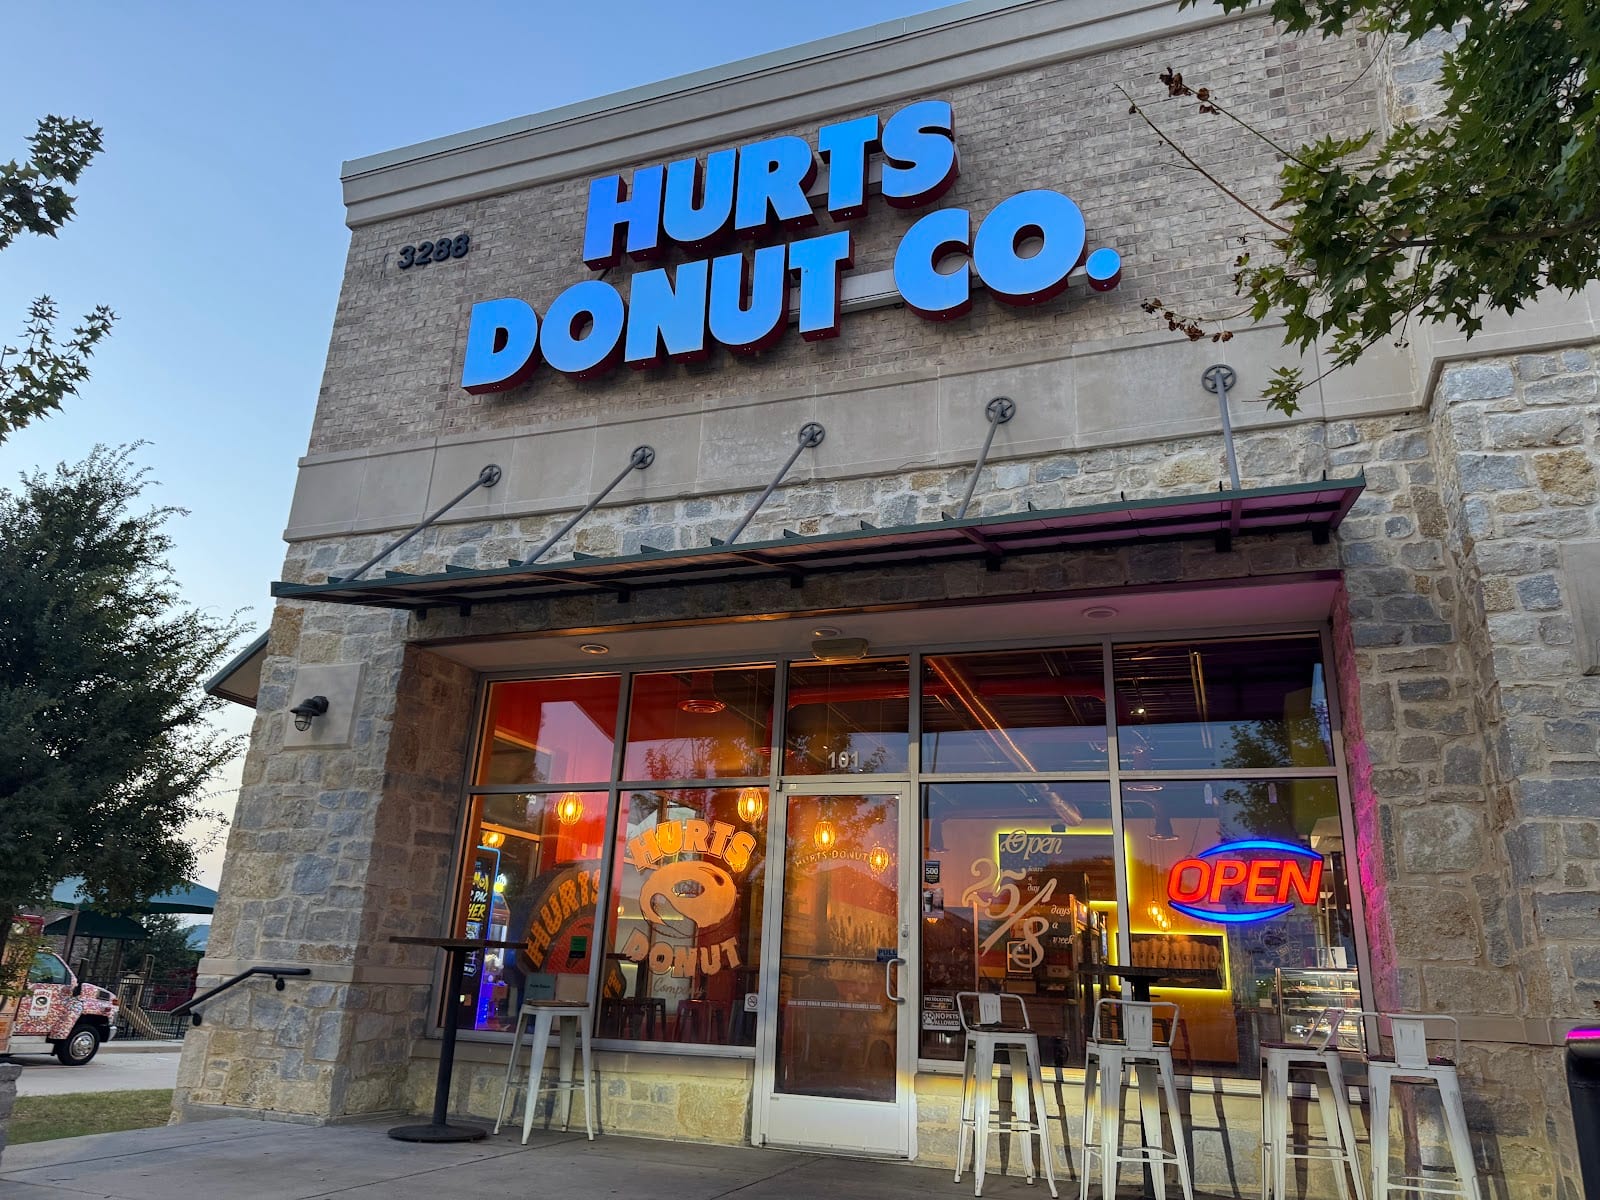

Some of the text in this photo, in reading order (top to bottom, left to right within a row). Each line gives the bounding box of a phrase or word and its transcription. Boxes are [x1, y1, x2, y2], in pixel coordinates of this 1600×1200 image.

[583, 100, 957, 267] HURTS
[398, 234, 469, 269] 3288
[461, 189, 1121, 394] DONUT CO.
[628, 818, 757, 872] HURTS
[1000, 829, 1062, 860] Open
[1027, 883, 1041, 893] day
[1167, 858, 1324, 905] OPEN
[1050, 905, 1072, 917] days
[1052, 922, 1059, 930] a
[622, 927, 742, 978] DONUT
